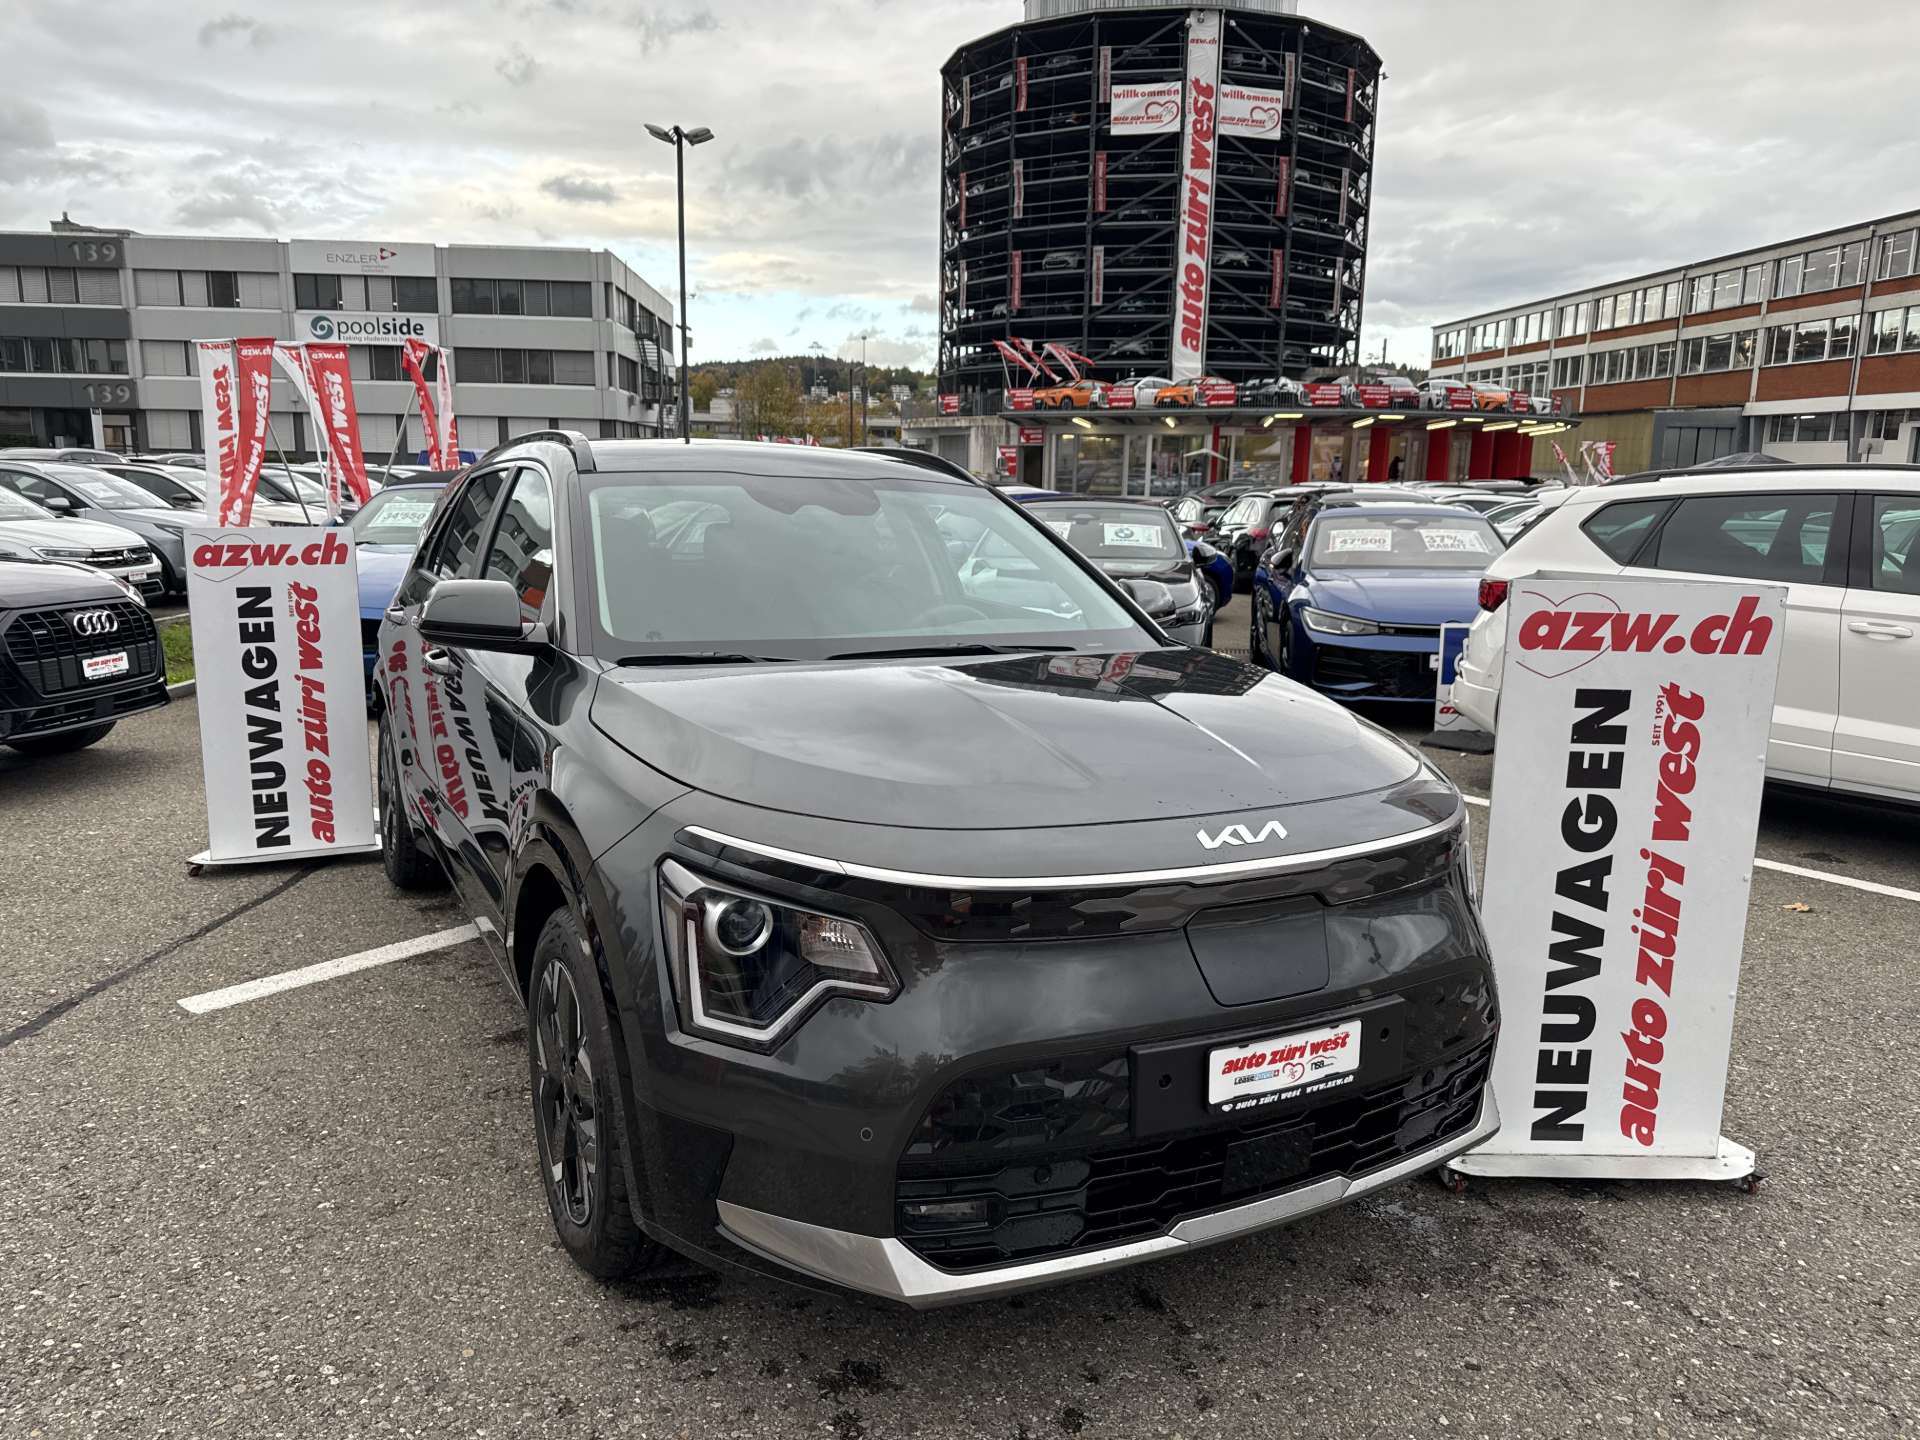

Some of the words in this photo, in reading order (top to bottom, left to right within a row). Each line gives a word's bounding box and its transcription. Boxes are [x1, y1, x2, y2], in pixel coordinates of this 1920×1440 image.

[1113, 89, 1180, 99] willkommen
[1222, 89, 1281, 104] willkommen
[1190, 76, 1214, 170] west
[1182, 174, 1209, 262] züri
[70, 241, 116, 262] 139
[326, 253, 378, 264] ENZLER
[337, 316, 425, 341] poolside
[1180, 263, 1205, 352] auto
[240, 345, 272, 357] azw.ch
[311, 351, 346, 361] azw.ch
[83, 383, 130, 403] 139
[251, 370, 269, 437] west
[323, 371, 349, 428] west
[193, 533, 349, 568] azw.ch
[288, 580, 324, 669] west
[1517, 596, 1774, 656] azw.ch
[236, 586, 291, 849] NEUWAGEN
[295, 674, 330, 757] züri
[1651, 723, 1662, 747] SEIT
[1655, 694, 1666, 719] 1991
[1650, 681, 1705, 843] west
[302, 758, 335, 844] auto
[1529, 687, 1632, 1143] NEUWAGEN
[1630, 847, 1686, 998] züri
[1221, 1051, 1267, 1075] auto
[1267, 1041, 1309, 1066] züri
[1310, 1032, 1350, 1056] west
[1619, 997, 1668, 1147] auto
[1235, 1099, 1257, 1110] auto
[1259, 1092, 1279, 1105] züri
[1280, 1088, 1301, 1101] west
